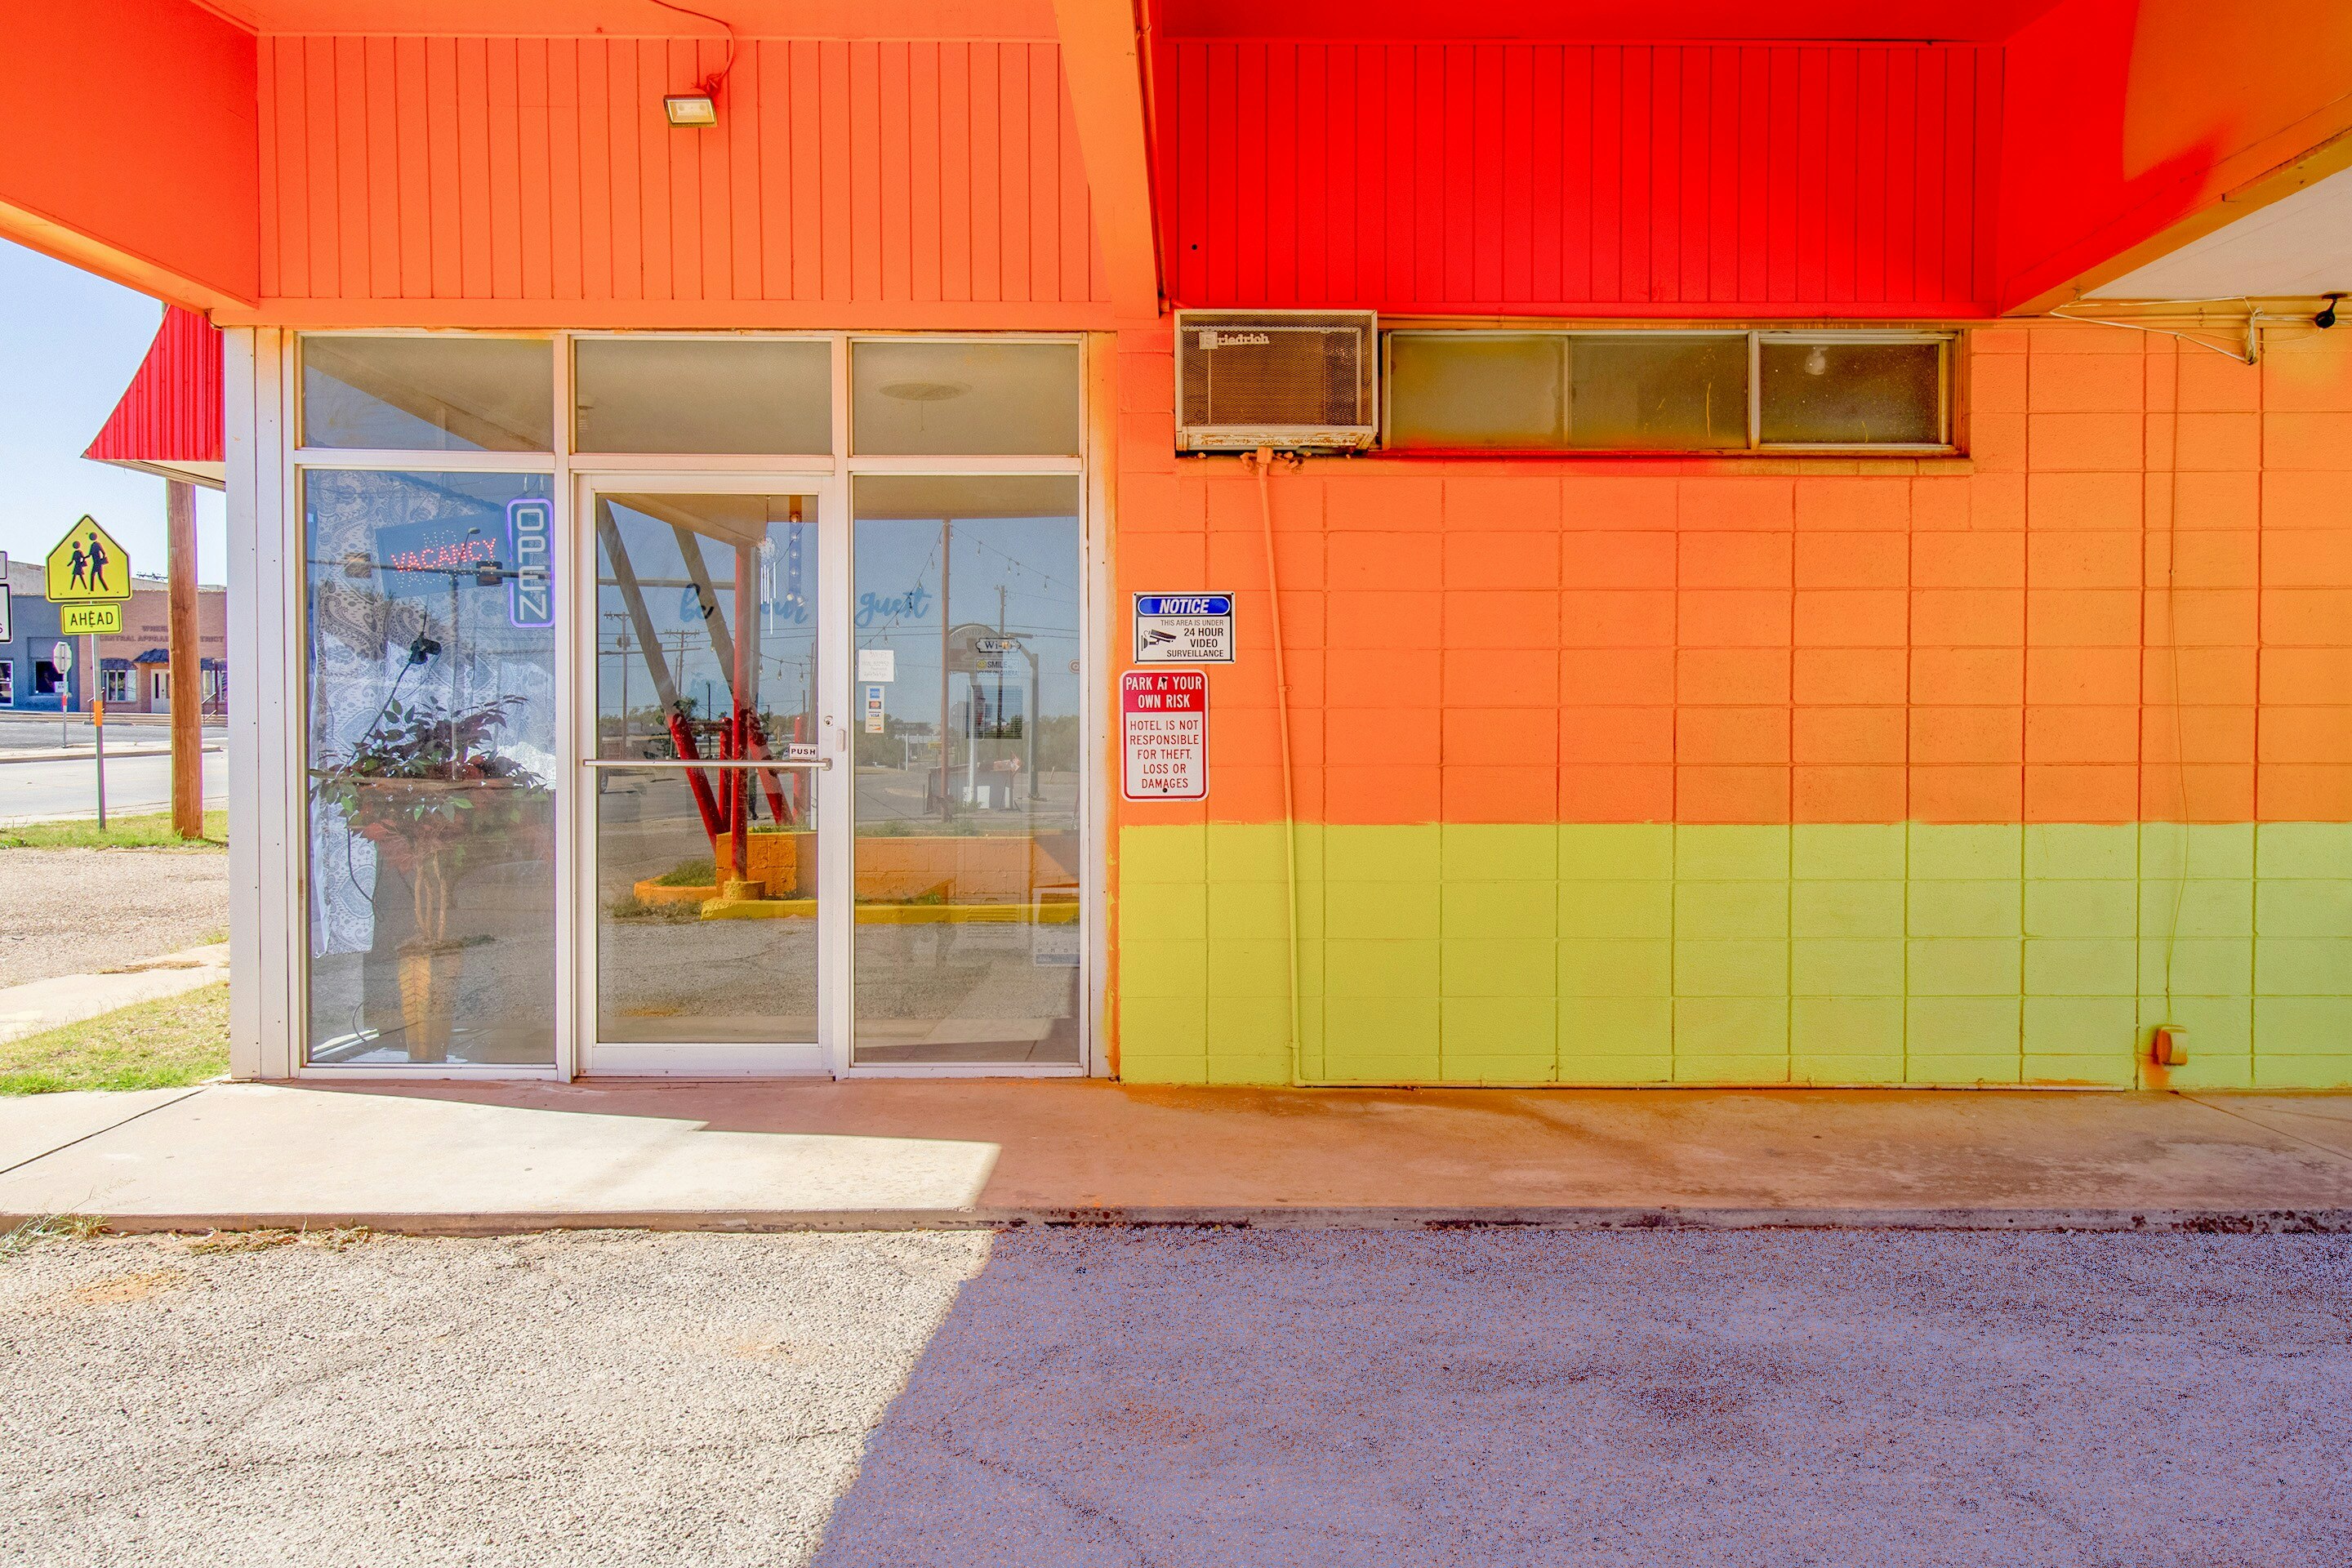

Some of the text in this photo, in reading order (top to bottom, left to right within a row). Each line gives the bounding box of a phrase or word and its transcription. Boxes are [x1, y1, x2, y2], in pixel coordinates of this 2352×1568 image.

[390, 537, 497, 573] VACANCY
[517, 508, 547, 621] OPEN
[854, 587, 932, 628] guest
[1159, 599, 1210, 614] NOTICE
[70, 612, 114, 626] AHEAD
[1184, 628, 1223, 636] 24 HOUR
[1190, 639, 1218, 648] VIDEO
[1166, 649, 1223, 657] SURVEILLANCE
[1125, 676, 1202, 691] PARK AT YOUR
[1138, 694, 1190, 708] OWN RISK
[1130, 719, 1199, 730] HOTEL IS NOT
[1130, 734, 1199, 745] RESPONSIBLE
[1138, 750, 1156, 760] FOR
[1143, 764, 1187, 774] LOSS OR
[1142, 778, 1188, 789] DAMAGES
